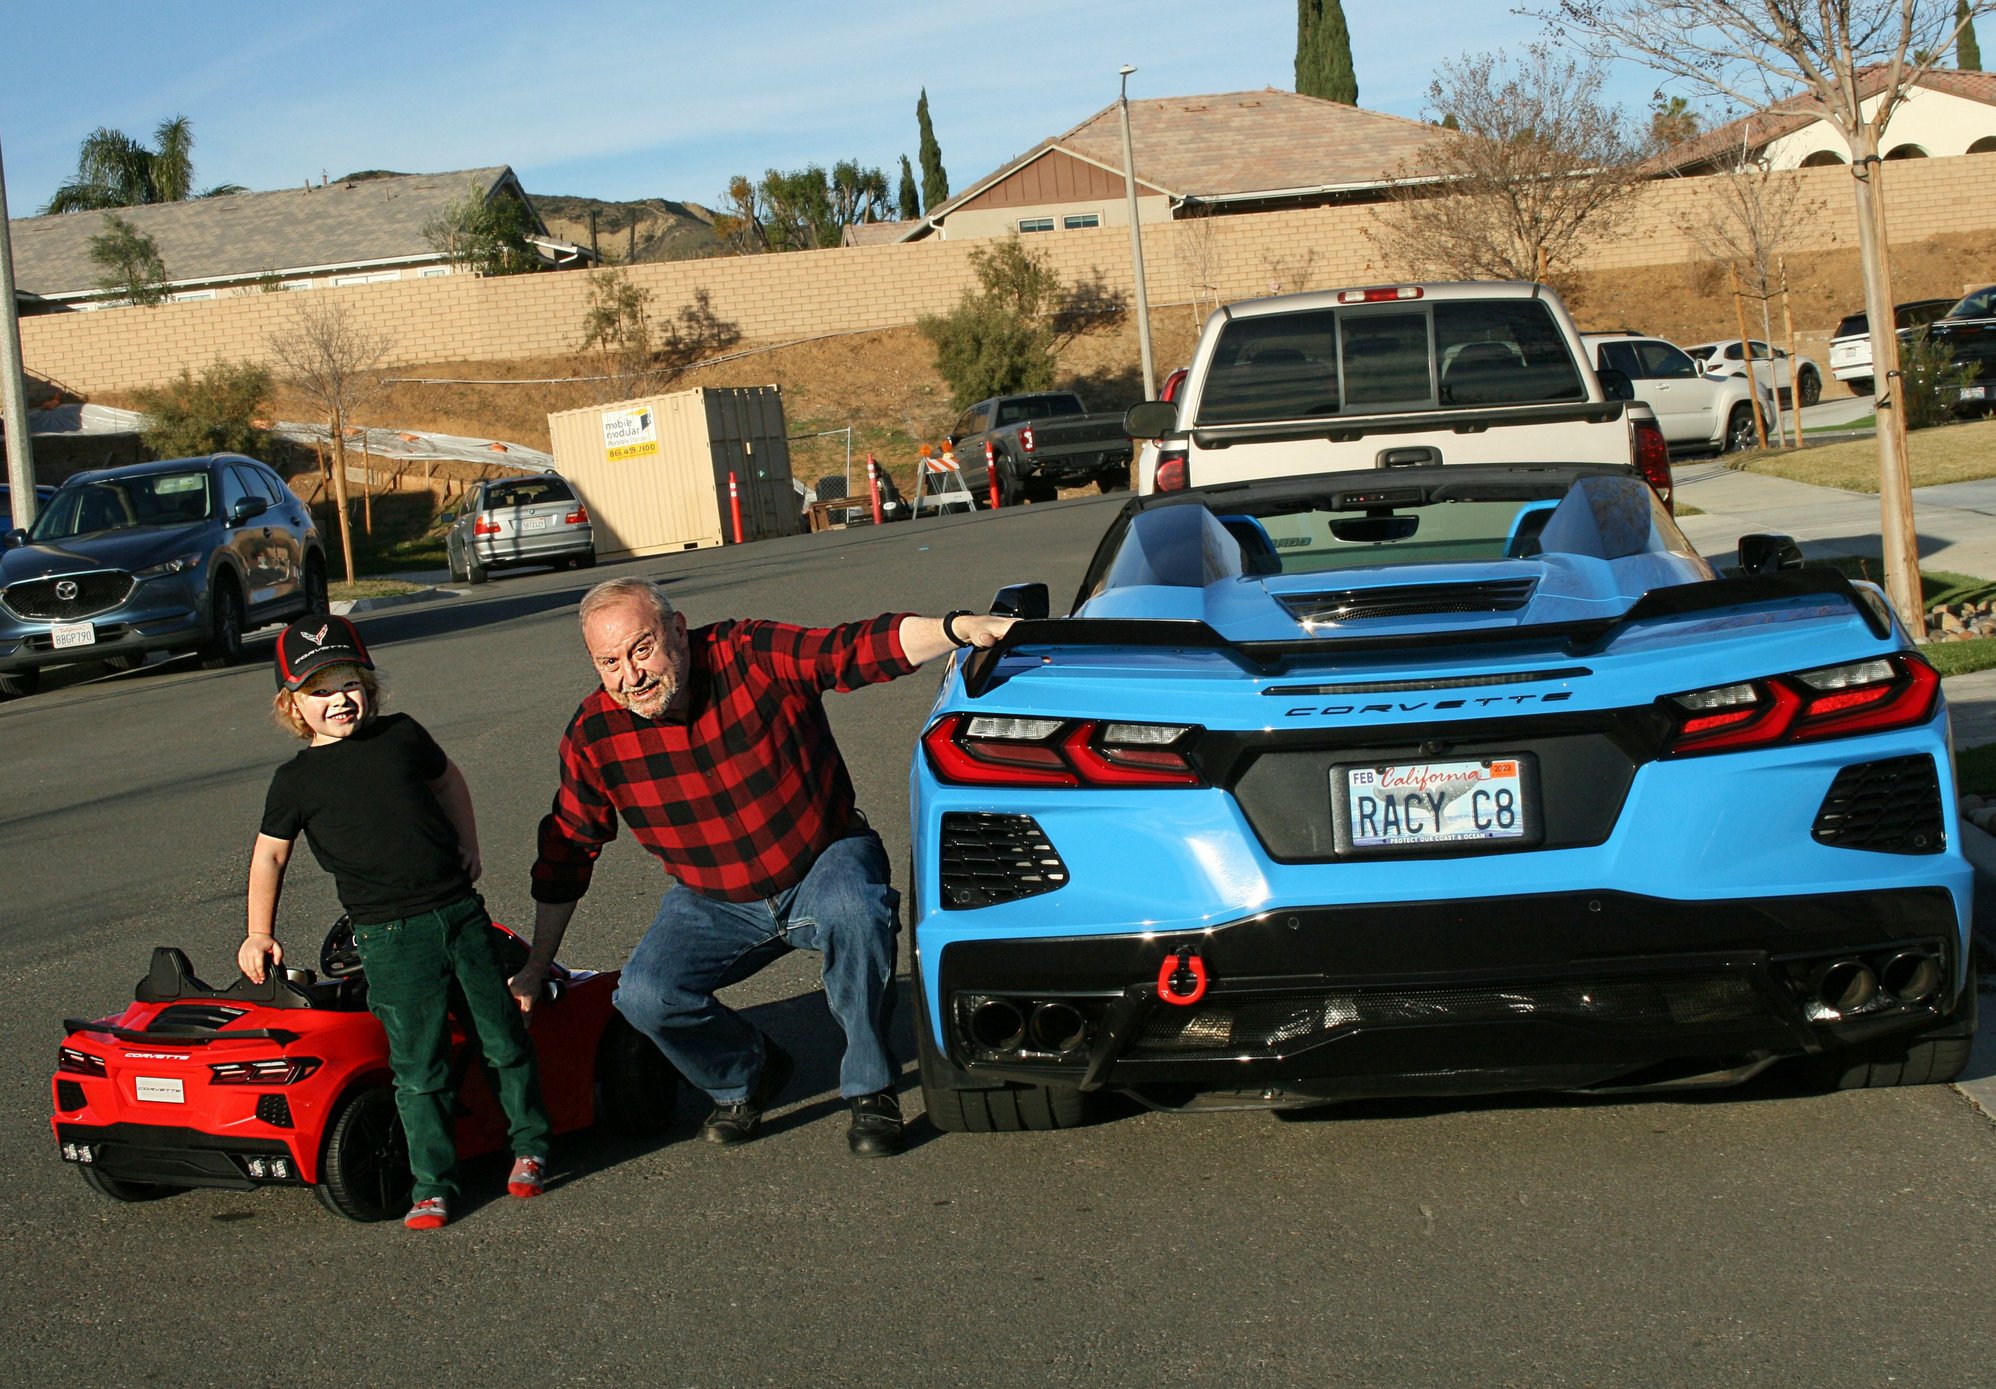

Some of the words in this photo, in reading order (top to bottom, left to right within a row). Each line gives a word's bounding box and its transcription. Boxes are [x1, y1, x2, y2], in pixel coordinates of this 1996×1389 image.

[605, 419, 632, 430] mobile
[606, 427, 640, 439] modular
[56, 631, 92, 645] 8BGP790
[1284, 692, 1573, 717] CORVETTE
[1353, 772, 1374, 785] FEB
[1381, 766, 1491, 791] California
[1494, 764, 1511, 772] 2023
[1358, 791, 1445, 837] RACY
[1472, 788, 1515, 830] C8
[124, 1052, 190, 1061] CORVETTE
